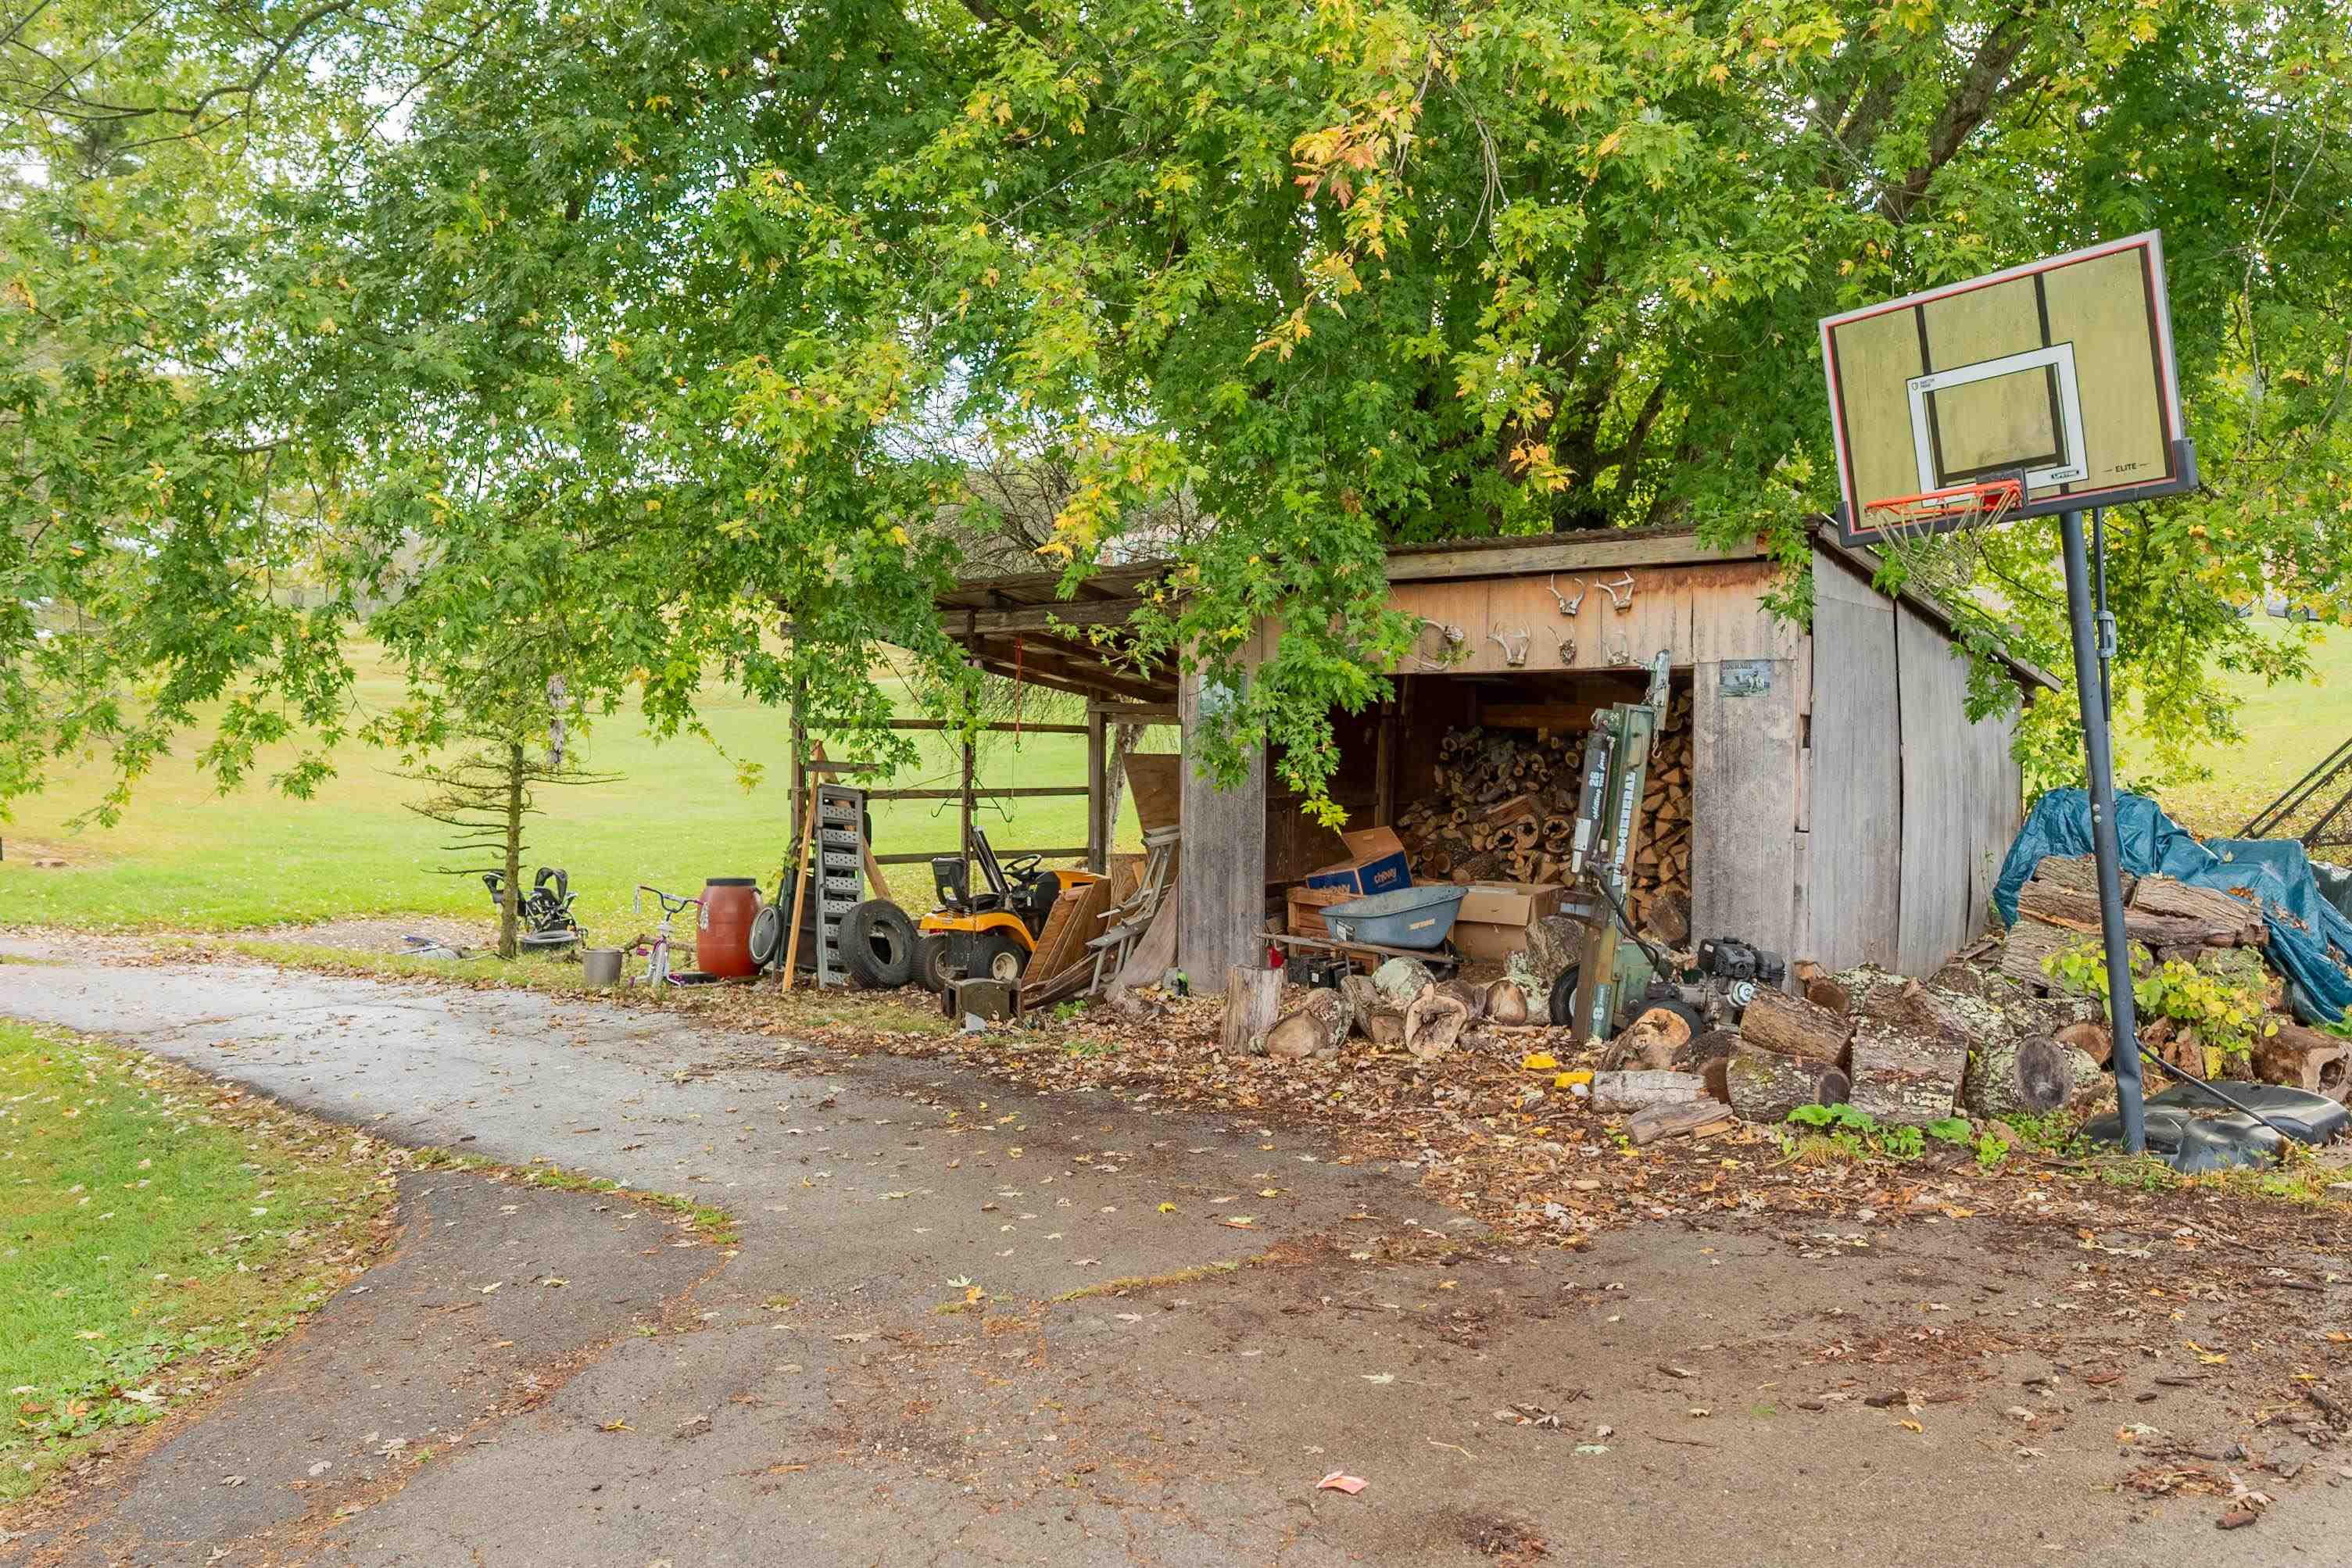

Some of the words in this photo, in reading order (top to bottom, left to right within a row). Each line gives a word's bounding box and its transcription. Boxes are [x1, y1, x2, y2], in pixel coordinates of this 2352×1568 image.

[2115, 463, 2137, 473] ELITE
[1588, 771, 1599, 787] 26
[1373, 867, 1395, 884] chewy
